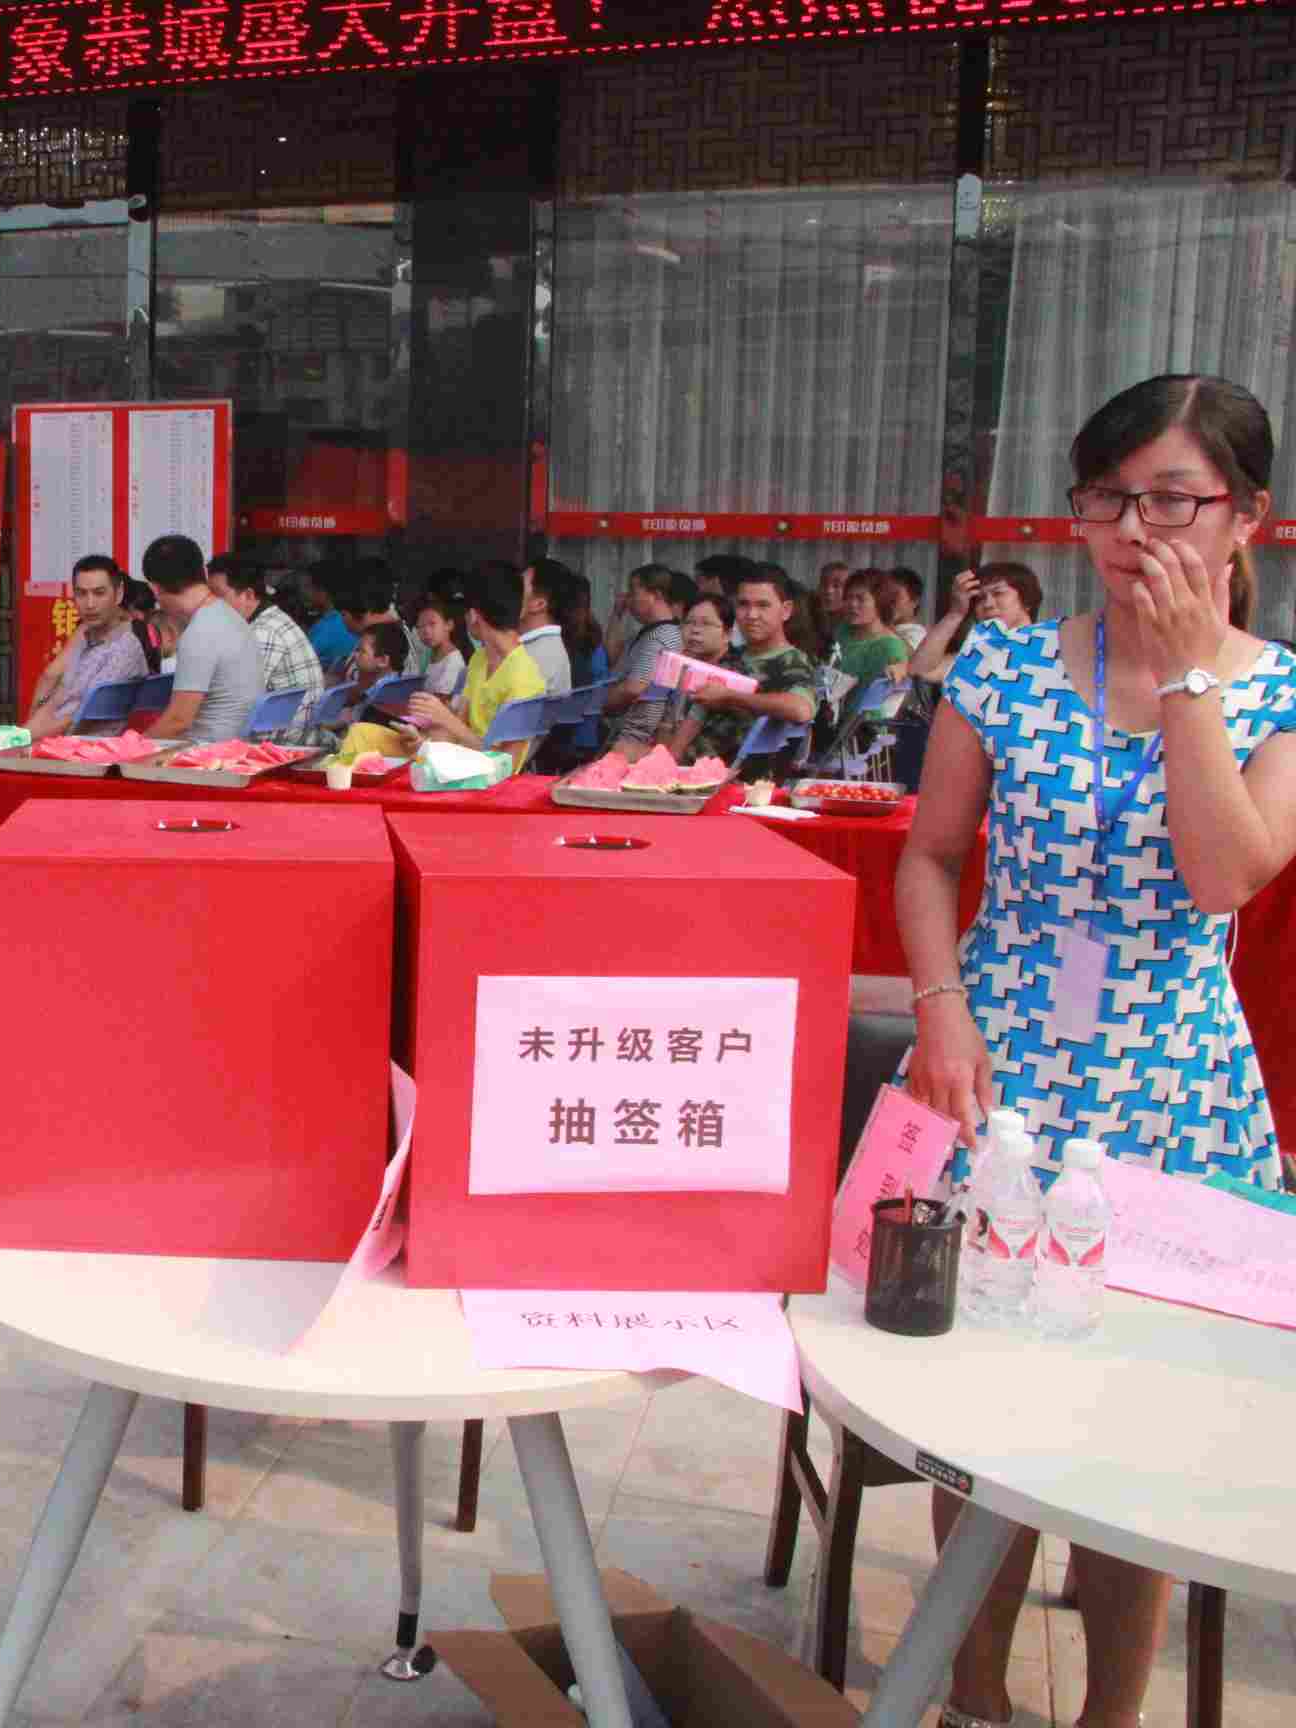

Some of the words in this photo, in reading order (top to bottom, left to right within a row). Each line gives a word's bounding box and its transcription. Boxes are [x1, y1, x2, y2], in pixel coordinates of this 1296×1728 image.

[518, 1026, 753, 1064] 未升级客户
[548, 1097, 726, 1148] 抽签箱
